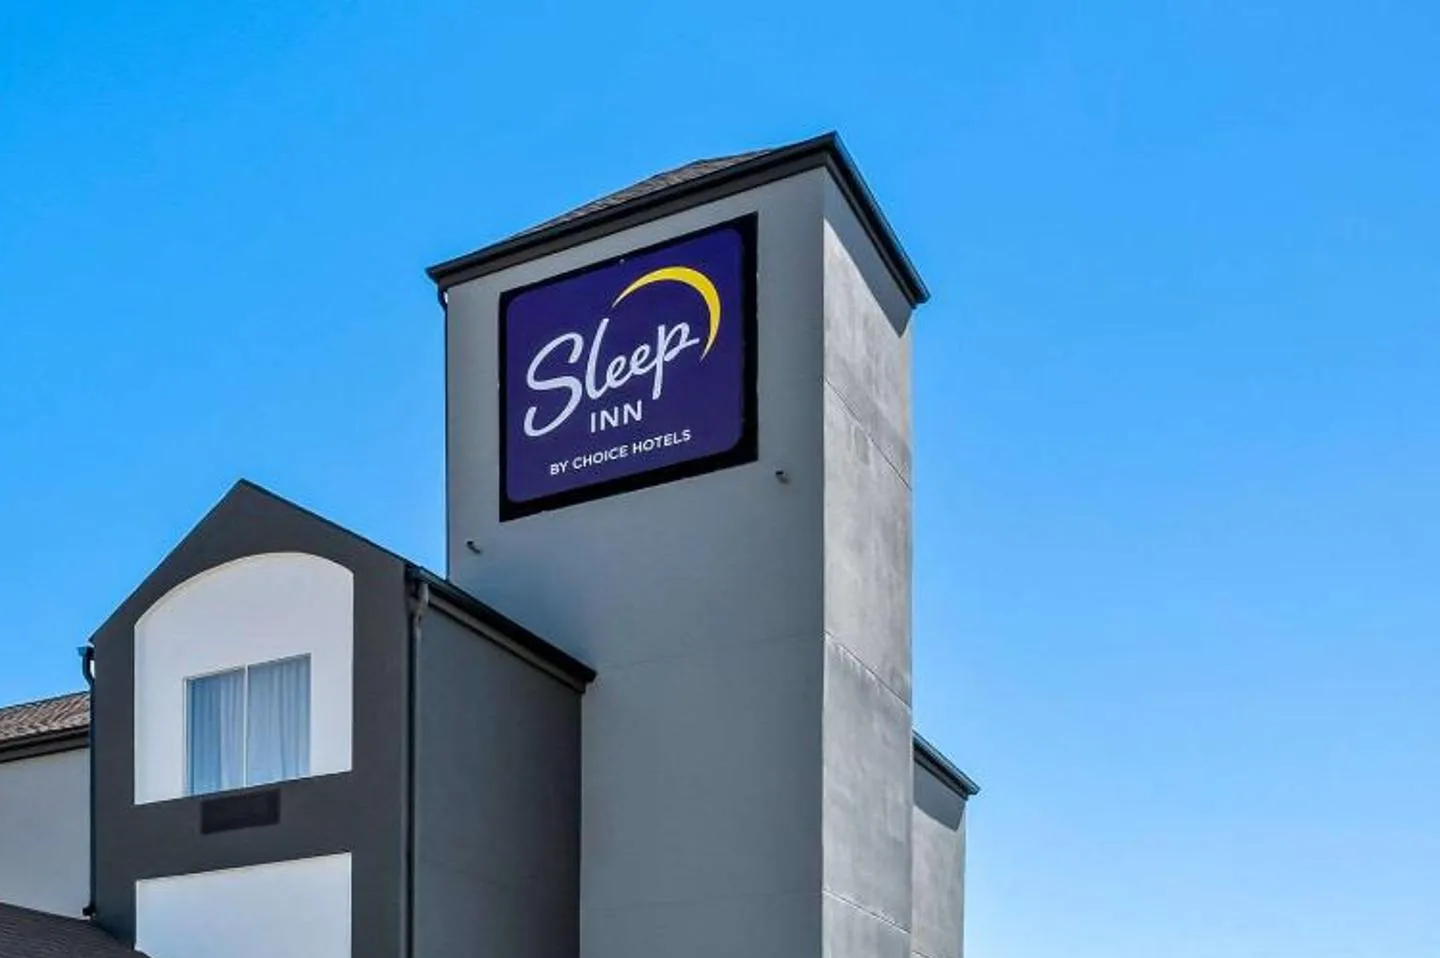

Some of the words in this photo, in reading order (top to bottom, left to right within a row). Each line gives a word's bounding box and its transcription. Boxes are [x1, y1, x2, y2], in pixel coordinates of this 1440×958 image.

[523, 318, 700, 437] Sleep
[590, 399, 643, 433] INN
[549, 460, 569, 475] BY
[572, 445, 629, 470] CHOICE
[632, 429, 692, 454] HOTELS
